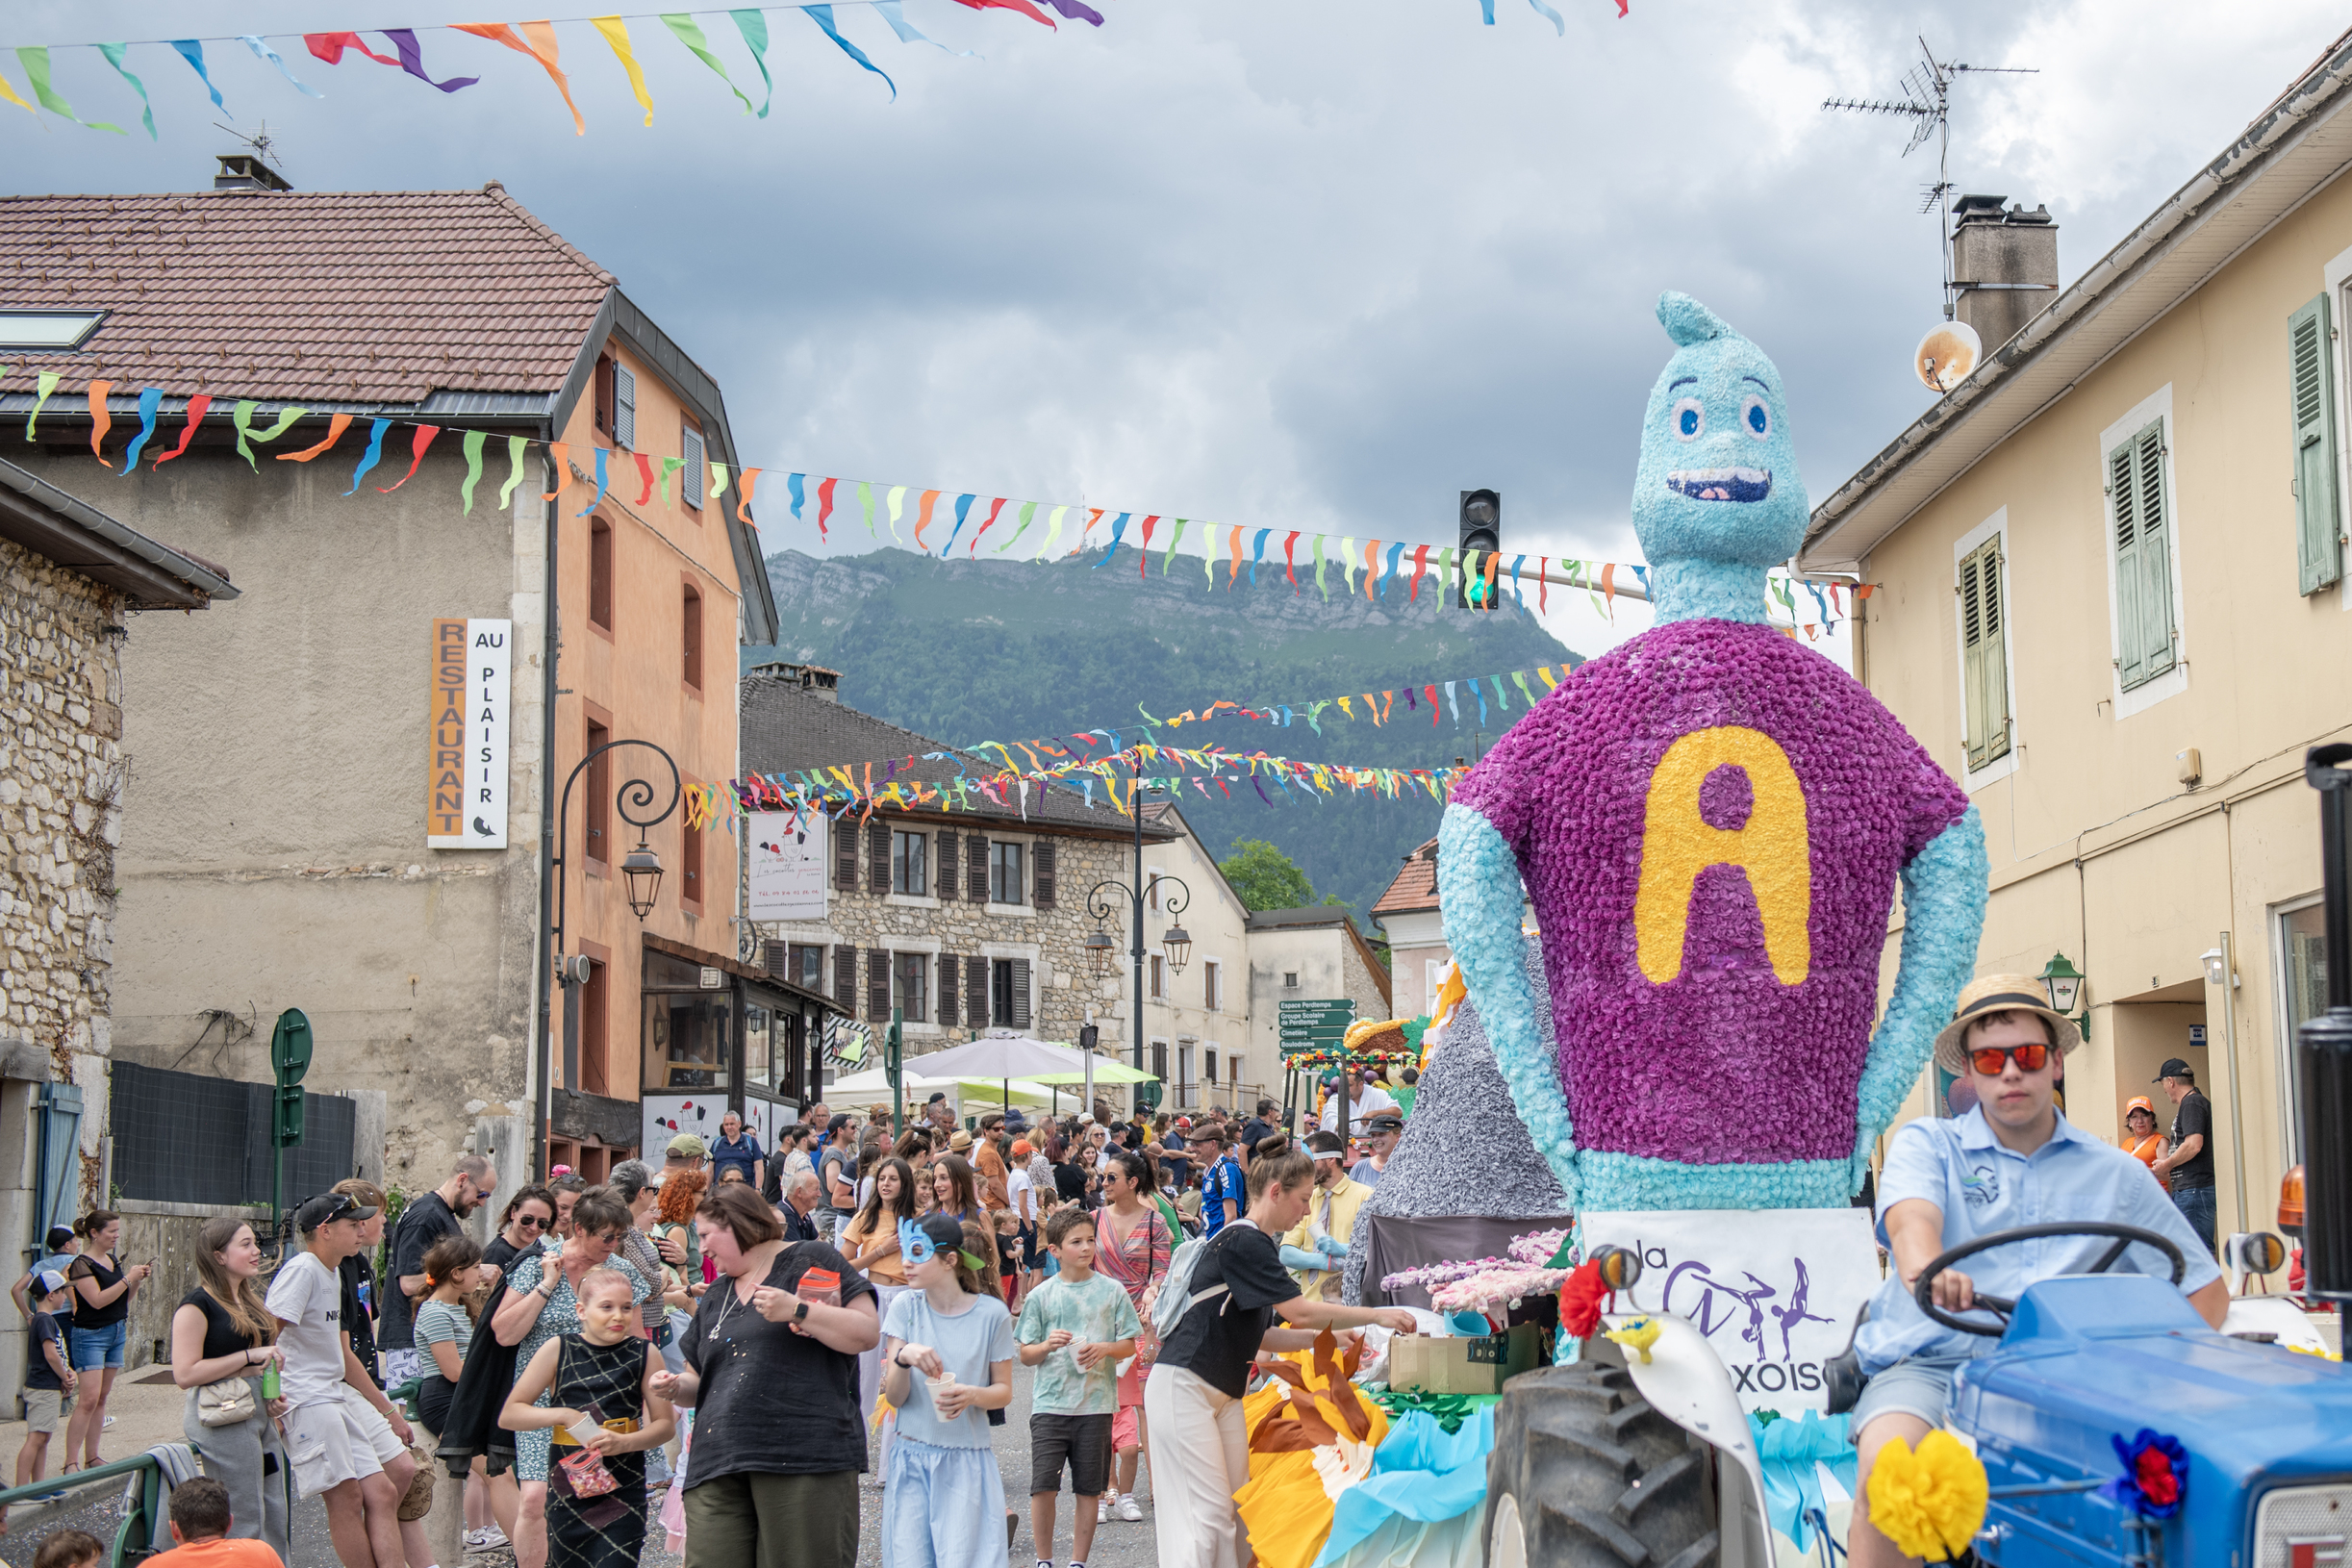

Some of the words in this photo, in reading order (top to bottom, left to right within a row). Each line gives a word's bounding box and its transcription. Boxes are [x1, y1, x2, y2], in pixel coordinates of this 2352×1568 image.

[475, 633, 503, 648] AU
[436, 623, 465, 832] RESTAURANT
[480, 668, 494, 803] PLAISIR
[1633, 725, 1810, 986] A
[1636, 1239, 1668, 1269] la
